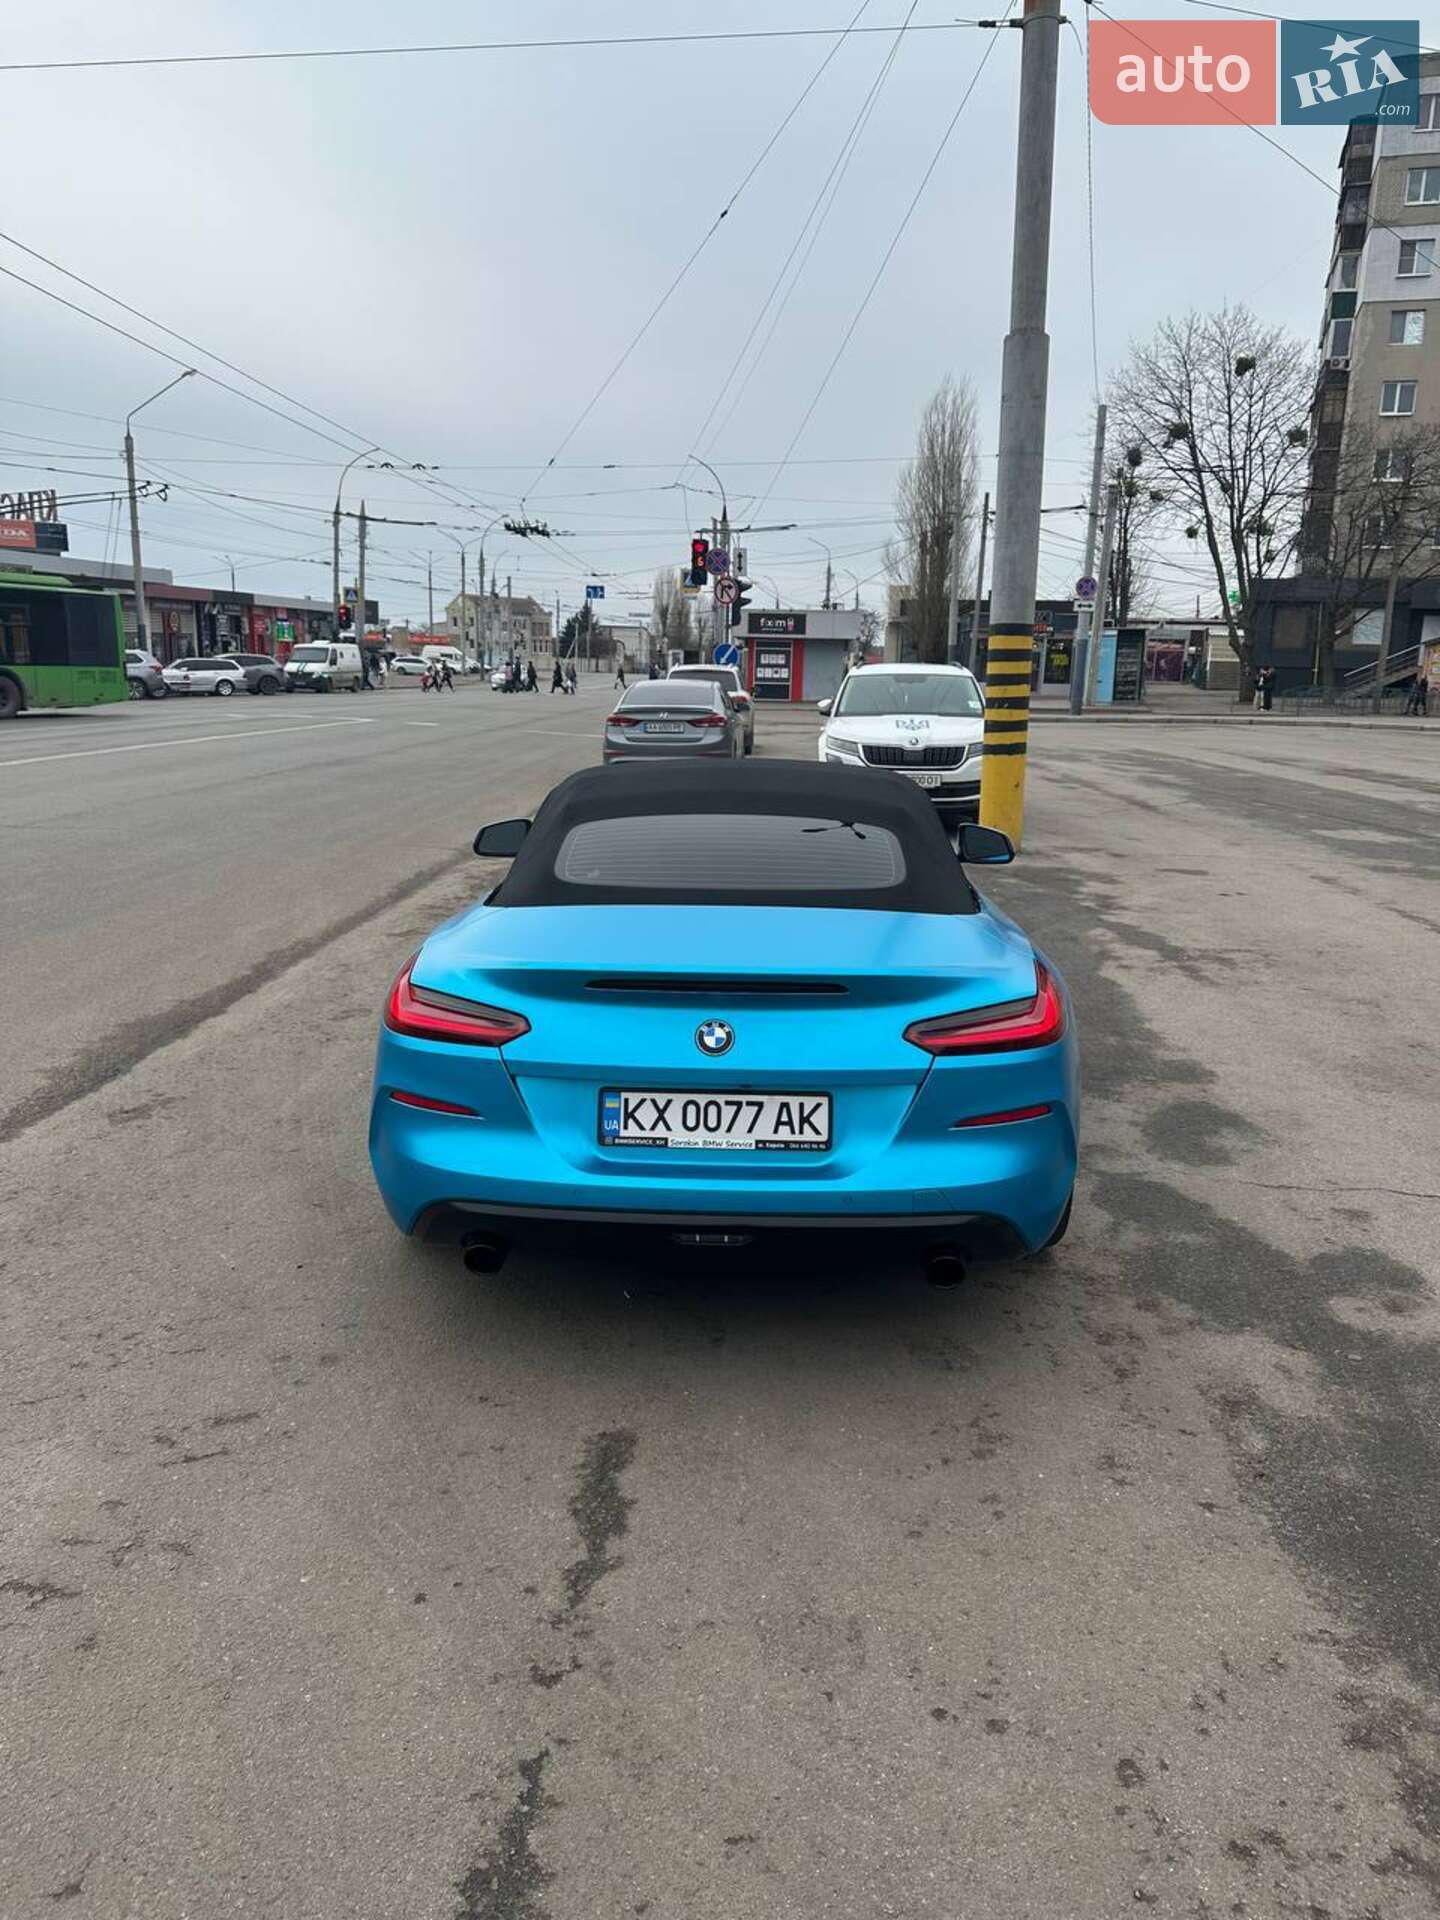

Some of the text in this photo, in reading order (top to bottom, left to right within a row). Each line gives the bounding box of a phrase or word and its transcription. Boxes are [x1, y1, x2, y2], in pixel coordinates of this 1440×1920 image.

[623, 1098, 823, 1135] KX 0077 AK
[604, 1119, 618, 1131] UA
[725, 1140, 753, 1148] Service
